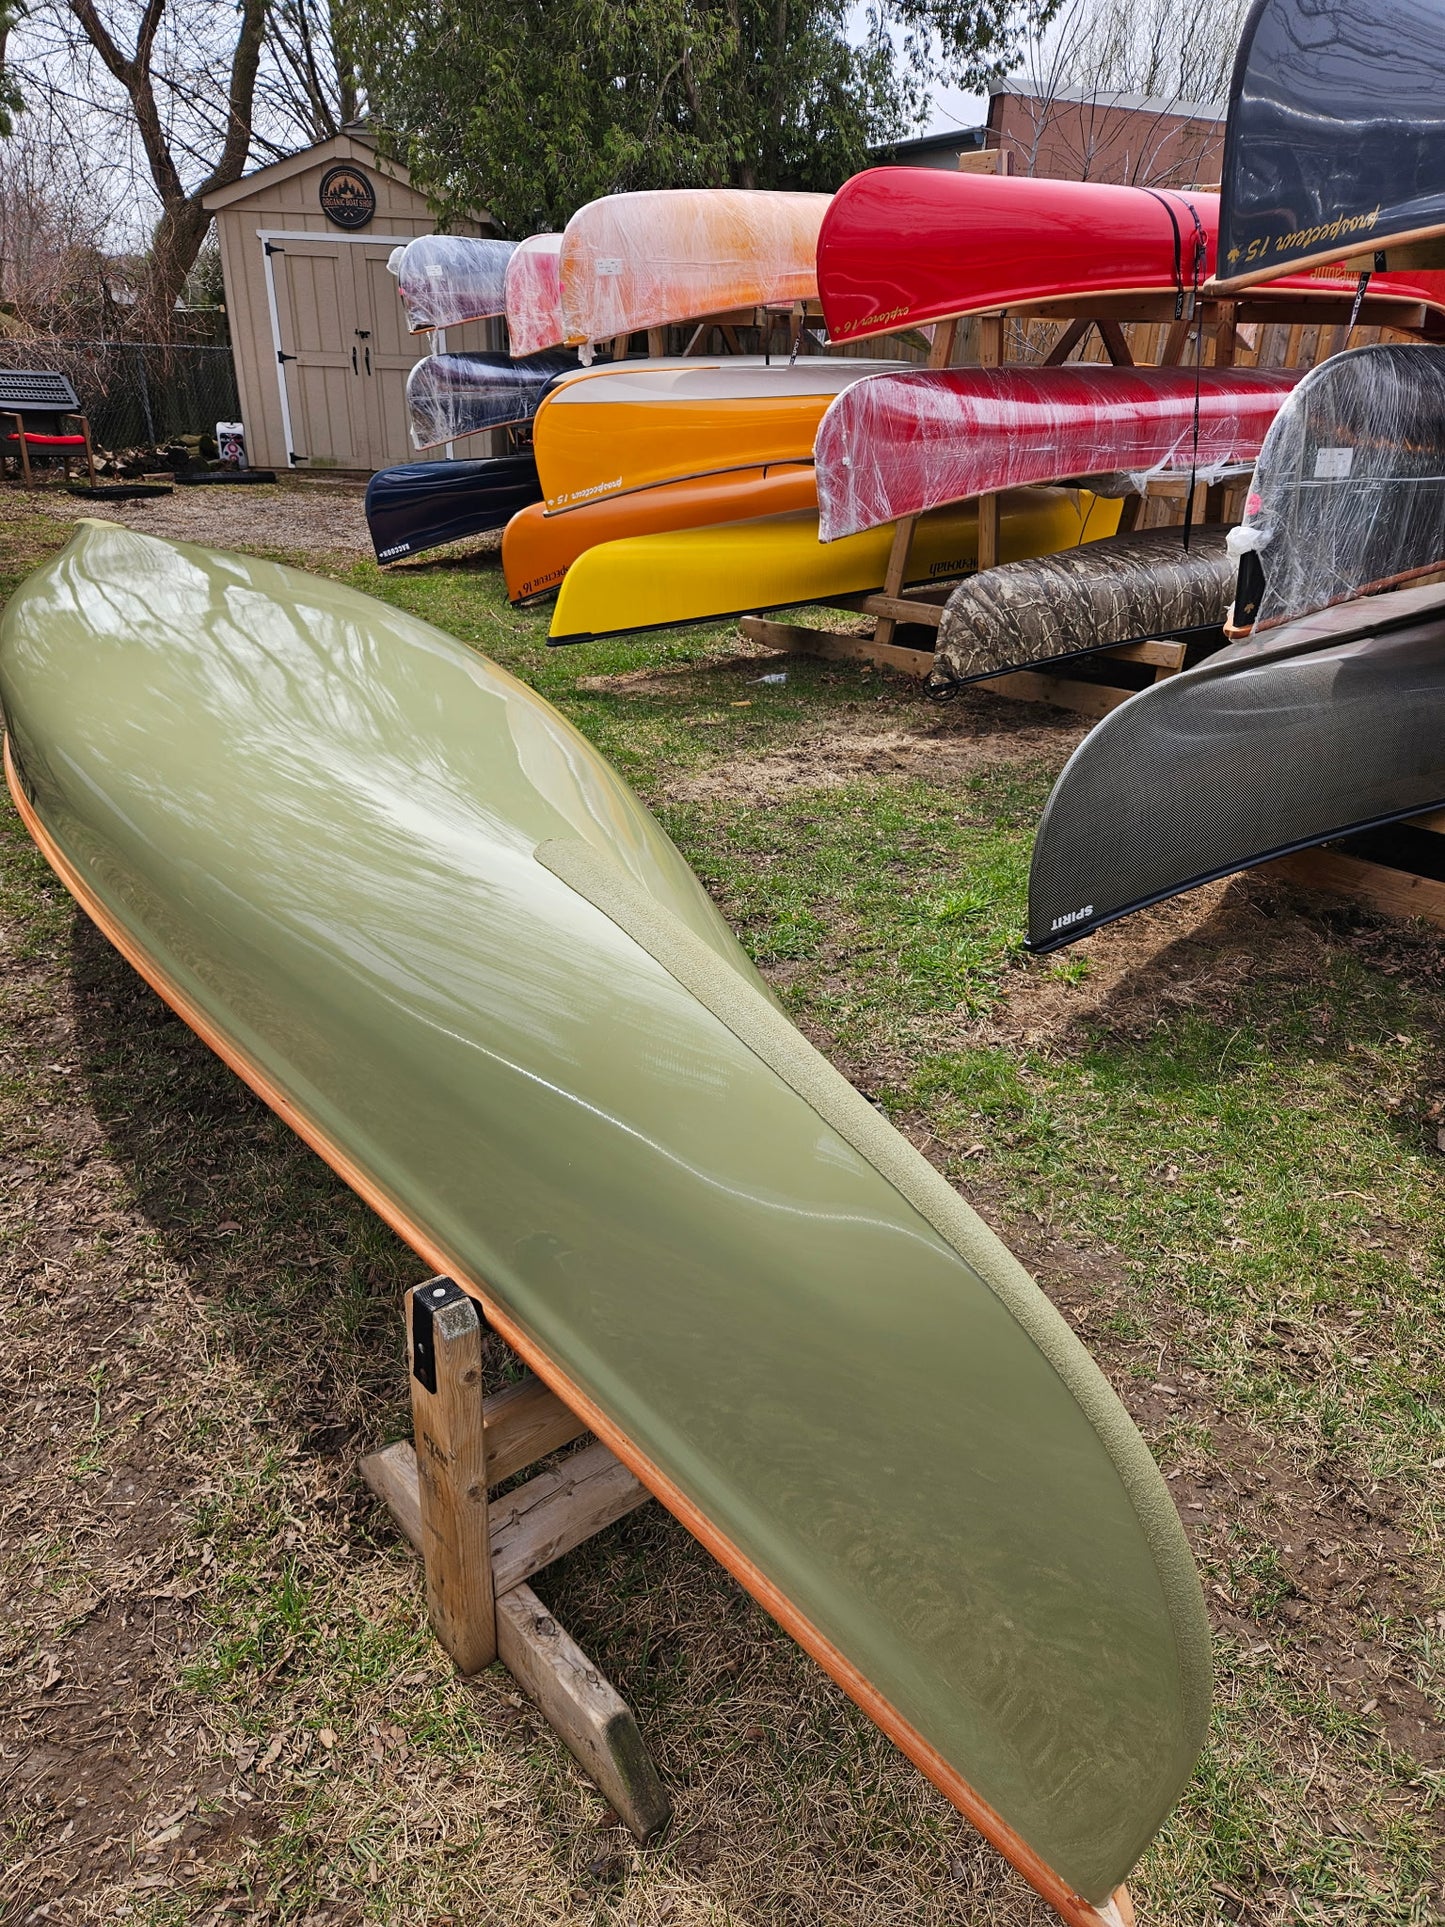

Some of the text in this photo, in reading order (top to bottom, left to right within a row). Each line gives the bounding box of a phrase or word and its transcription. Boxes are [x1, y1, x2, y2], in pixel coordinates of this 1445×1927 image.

[323, 197, 373, 209] ORGANIC BOAT SHOP
[1245, 203, 1381, 262] prospecteur 15
[843, 306, 910, 333] explorer 16
[556, 475, 623, 505] prospecteur 15
[382, 543, 410, 557] RACCOON
[522, 581, 533, 593] 16
[1050, 904, 1094, 931] SPIRIT
